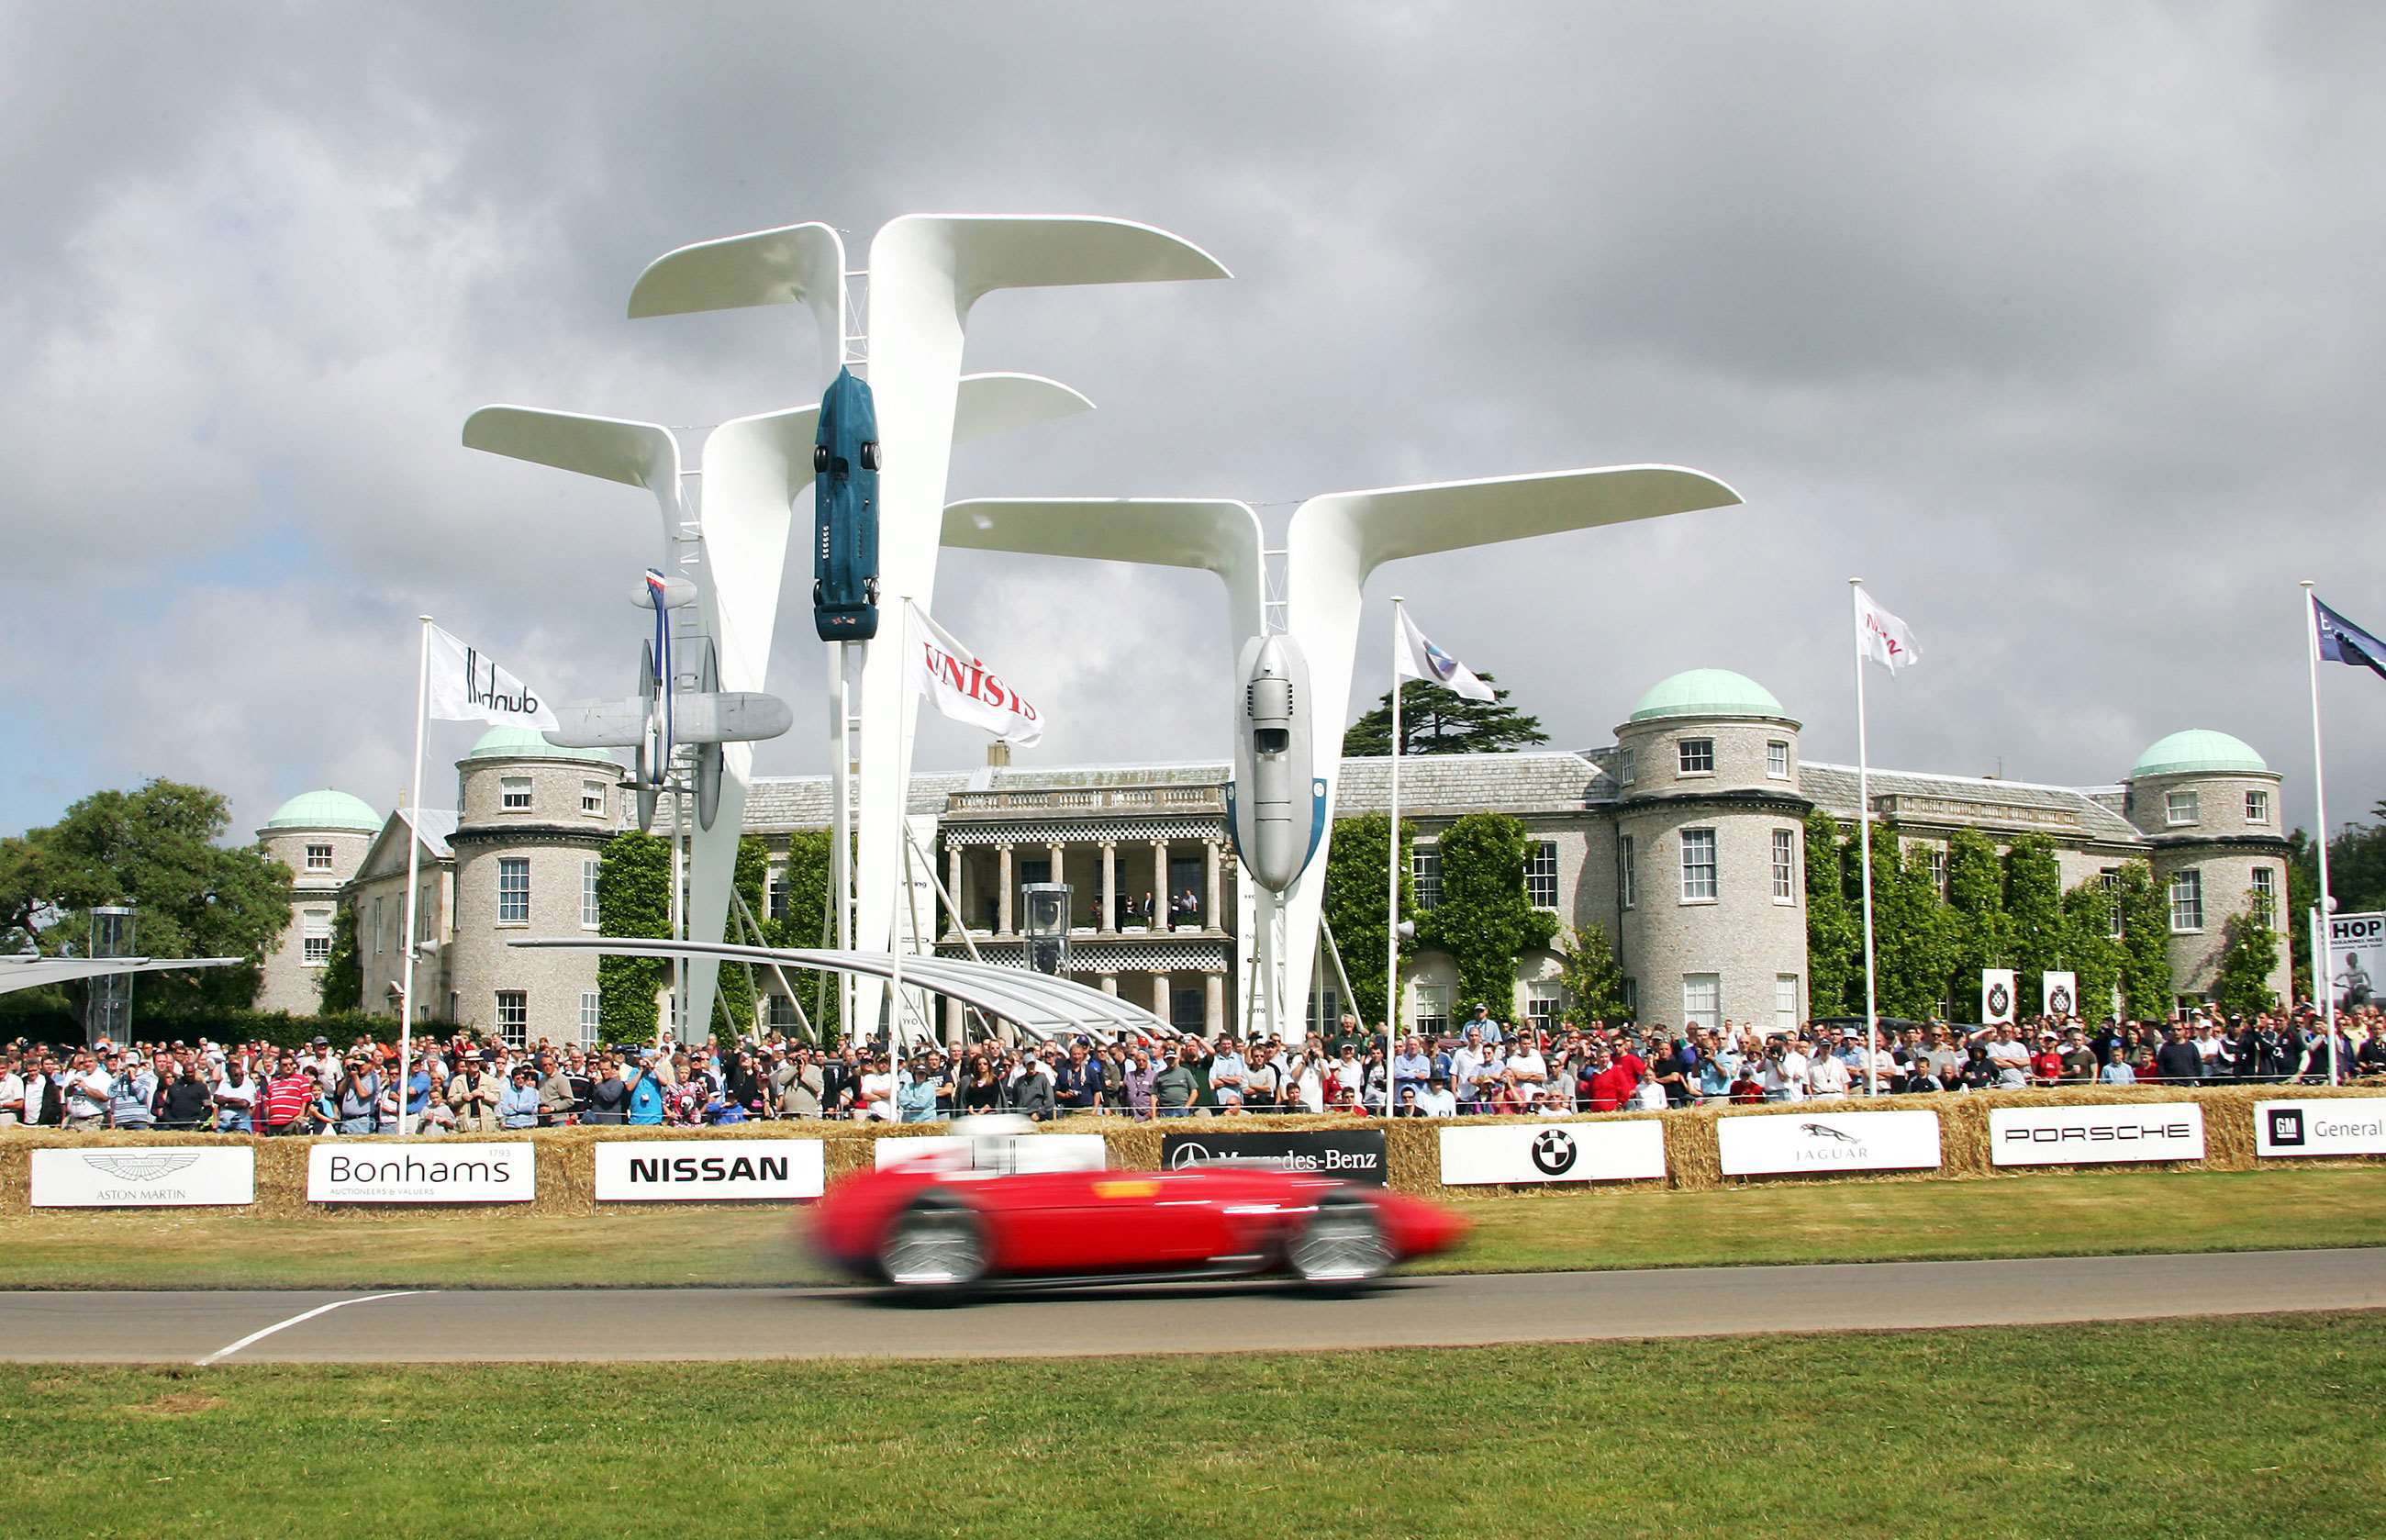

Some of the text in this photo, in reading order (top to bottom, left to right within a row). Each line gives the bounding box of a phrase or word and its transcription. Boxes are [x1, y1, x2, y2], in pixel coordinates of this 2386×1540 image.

[2333, 921, 2381, 938] HOP
[2005, 1123, 2190, 1144] PORSCHE
[2277, 1118, 2296, 1133] GM
[2314, 1119, 2382, 1137] General
[489, 1149, 511, 1157] 1793
[1796, 1147, 1868, 1162] JAGUAR
[330, 1155, 510, 1182] Bonhams
[630, 1157, 787, 1183] NISSAN
[97, 1188, 186, 1200] ASTON MARTIN
